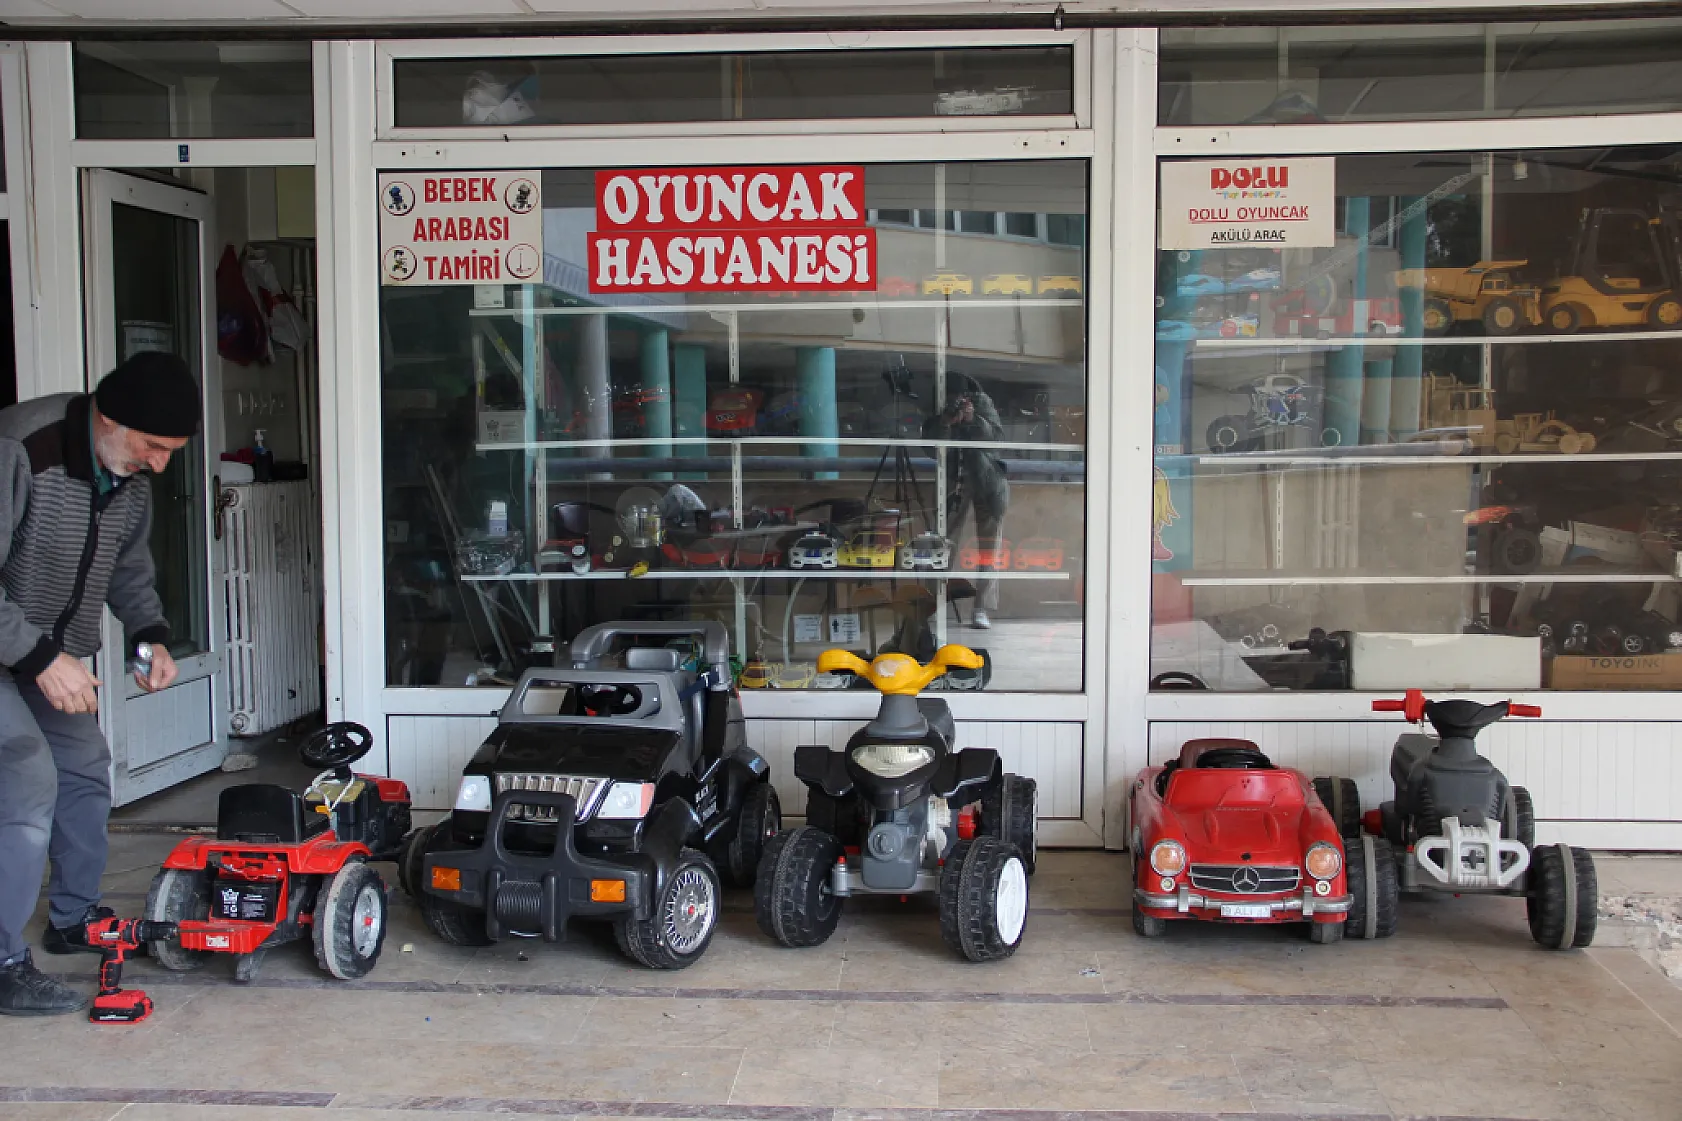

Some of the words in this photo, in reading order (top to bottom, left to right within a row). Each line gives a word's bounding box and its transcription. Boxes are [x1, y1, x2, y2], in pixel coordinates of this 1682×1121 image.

[424, 177, 497, 203] BEBEK
[1211, 166, 1288, 189] DOLU
[603, 172, 858, 225] OYUNCAK
[1189, 208, 1229, 221] DOLU
[1236, 205, 1309, 220] OYUNCAK
[413, 215, 509, 242] ARABASI
[1210, 228, 1251, 241] AKÜLÜ
[423, 248, 500, 280] TAMİRİ
